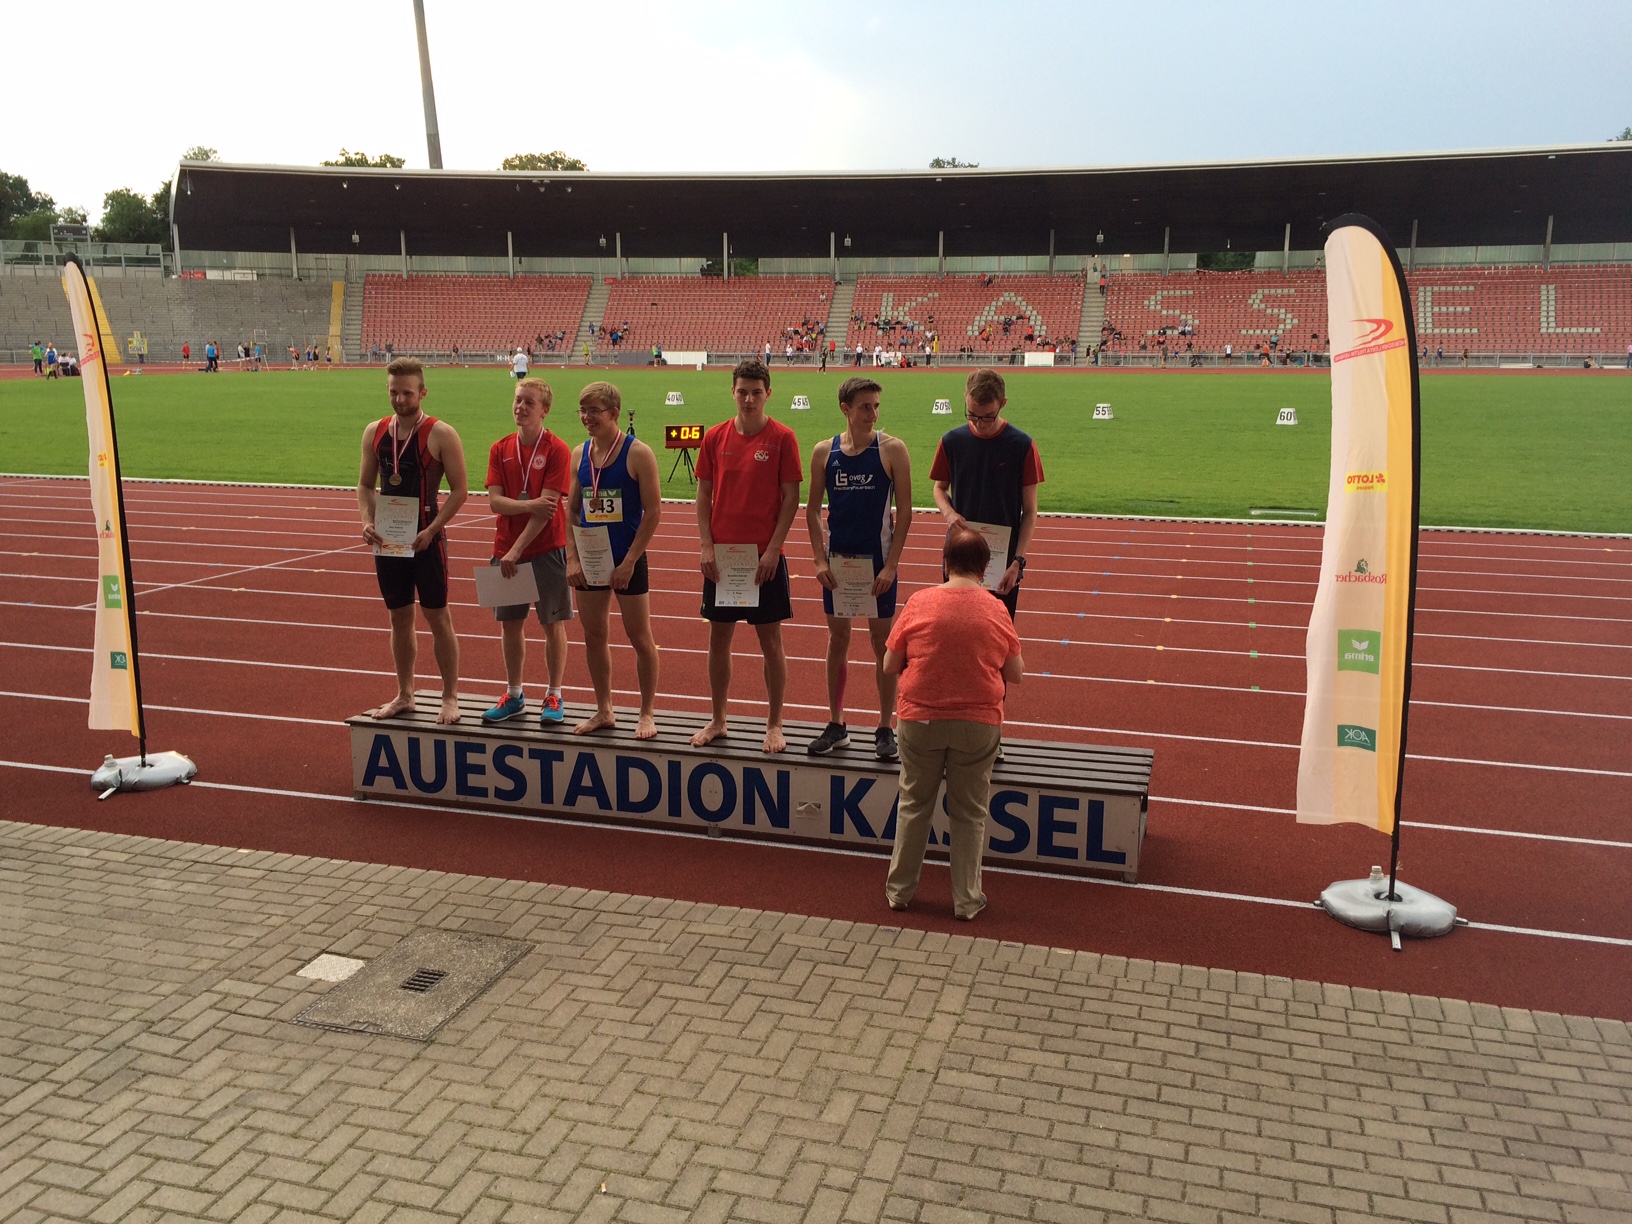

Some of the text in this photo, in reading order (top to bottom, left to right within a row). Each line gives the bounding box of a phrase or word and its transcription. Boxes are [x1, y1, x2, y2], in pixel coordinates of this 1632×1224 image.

[935, 402, 944, 411] 50
[1095, 406, 1106, 415] 55
[1279, 411, 1292, 422] 60
[680, 427, 700, 440] 0.6
[361, 734, 1127, 865] AUESTADION KSEL
